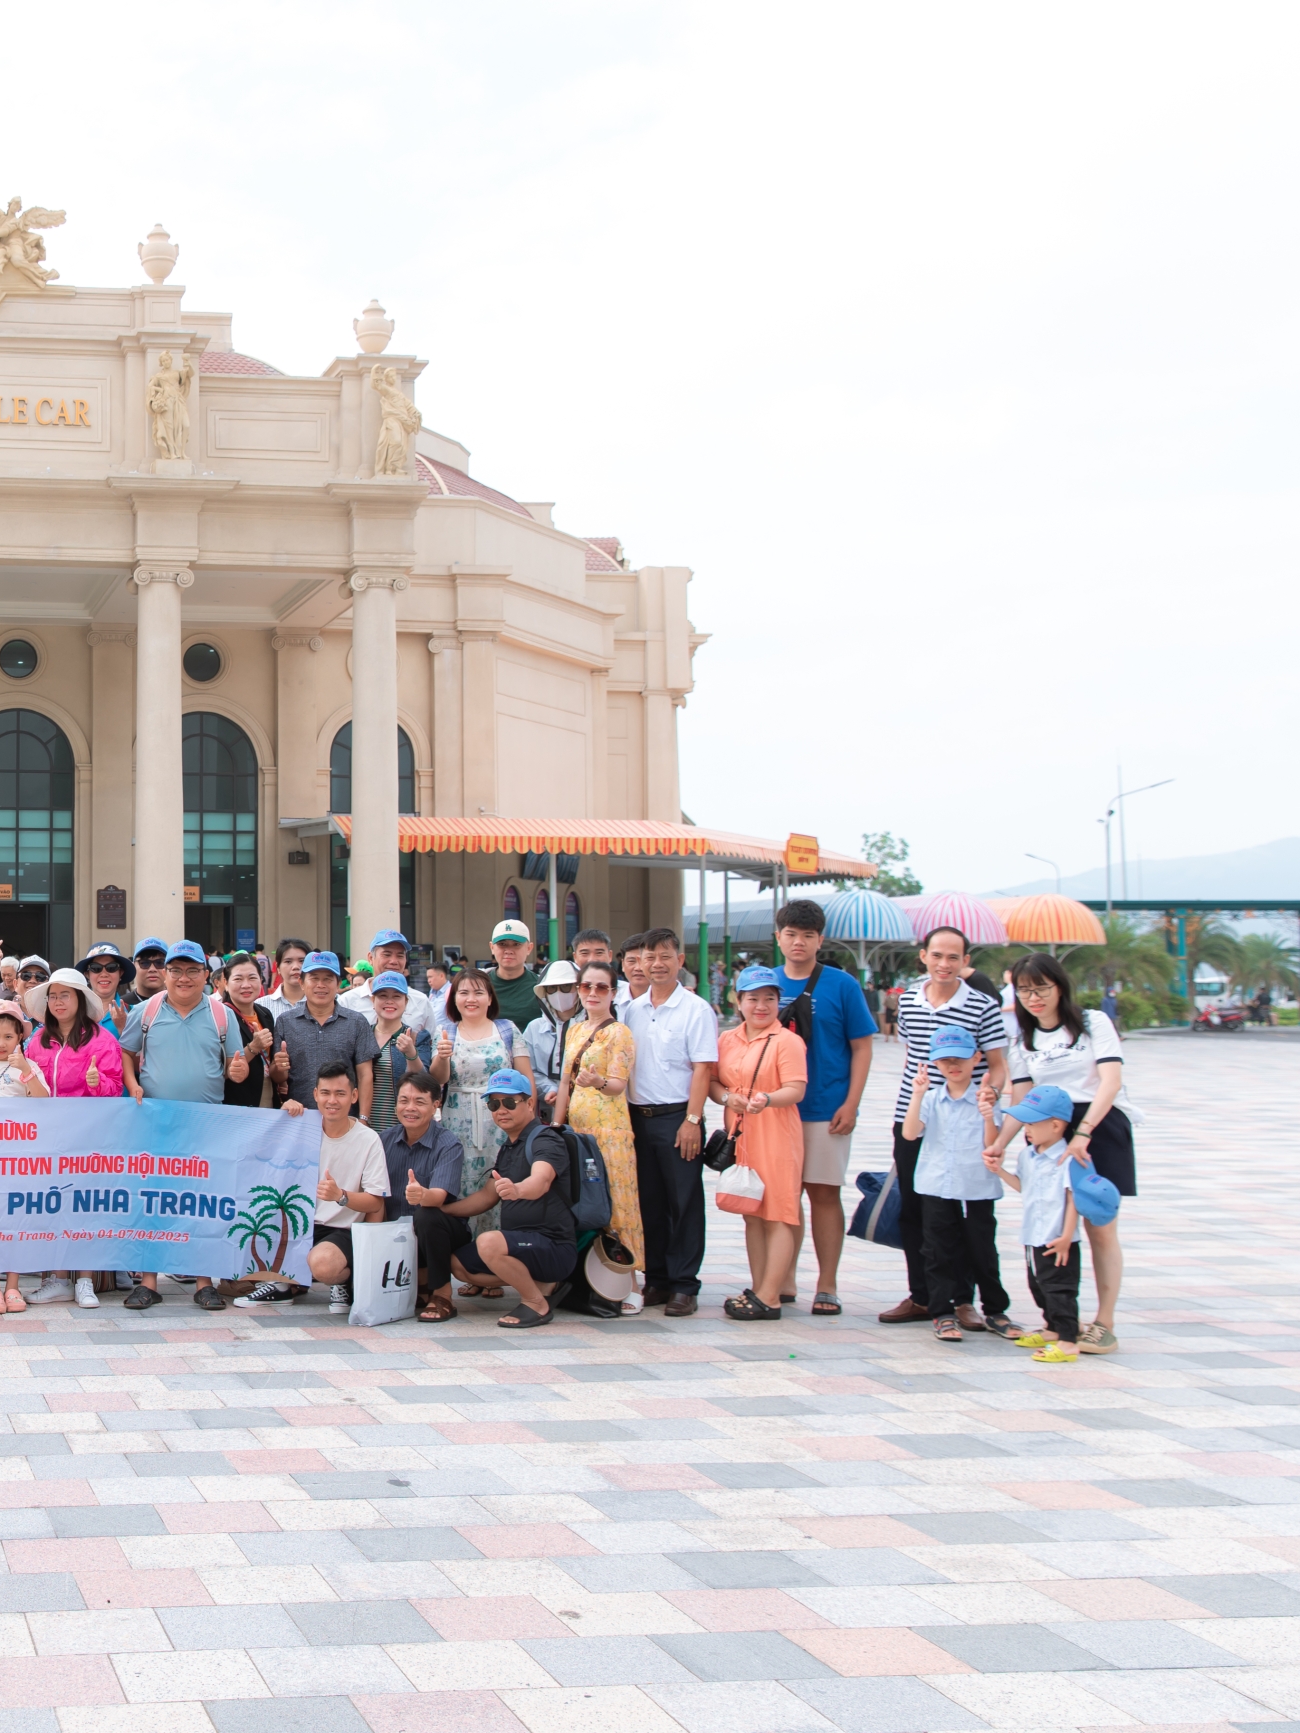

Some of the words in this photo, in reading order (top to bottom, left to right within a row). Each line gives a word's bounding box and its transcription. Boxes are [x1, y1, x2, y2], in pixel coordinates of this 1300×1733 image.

[35, 398, 92, 427] CAR
[58, 1152, 124, 1174] PHƯỜNG
[128, 1154, 154, 1178] HỘI
[158, 1155, 209, 1178] NGHĨA
[8, 1184, 74, 1215] PHỐ
[73, 1190, 129, 1213] NHA
[141, 1190, 236, 1221] TRANG
[18, 1230, 57, 1242] Trang,
[61, 1230, 94, 1242] Ngày
[97, 1229, 189, 1242] 04-07/04/2025
